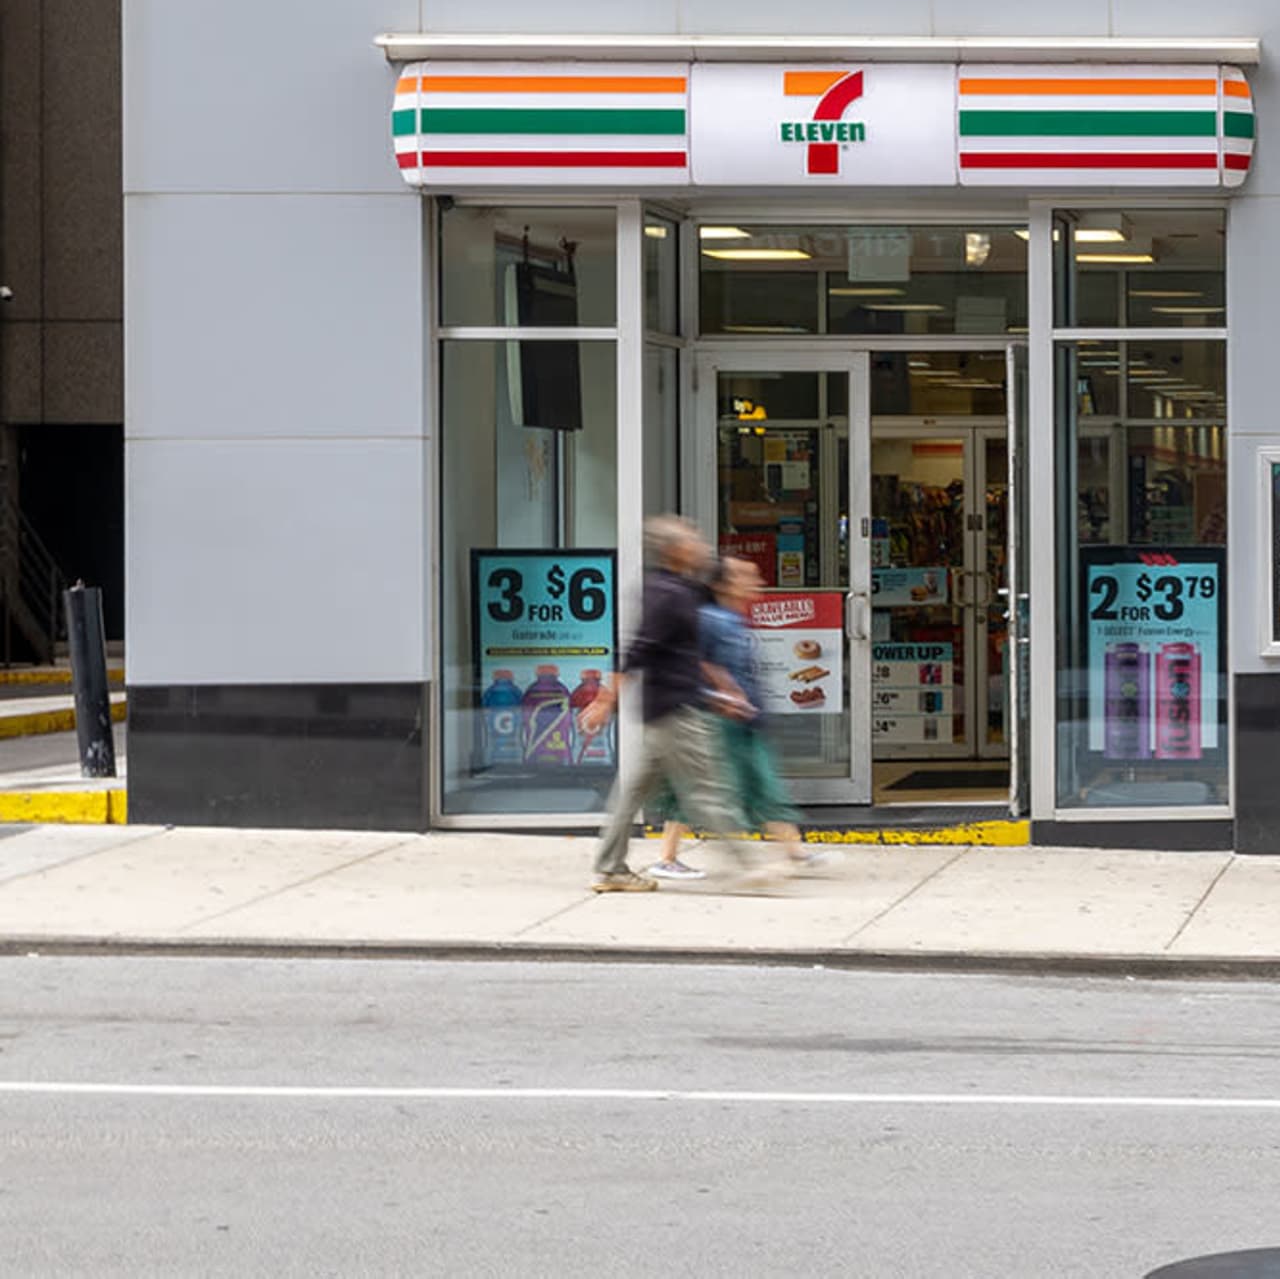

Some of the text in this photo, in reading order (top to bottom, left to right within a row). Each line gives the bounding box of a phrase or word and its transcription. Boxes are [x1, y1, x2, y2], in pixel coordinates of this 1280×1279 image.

[487, 564, 606, 622] 3 FOR $6
[1091, 575, 1119, 620] 2
[1121, 607, 1150, 620] FOR
[873, 645, 944, 660] OWER UP
